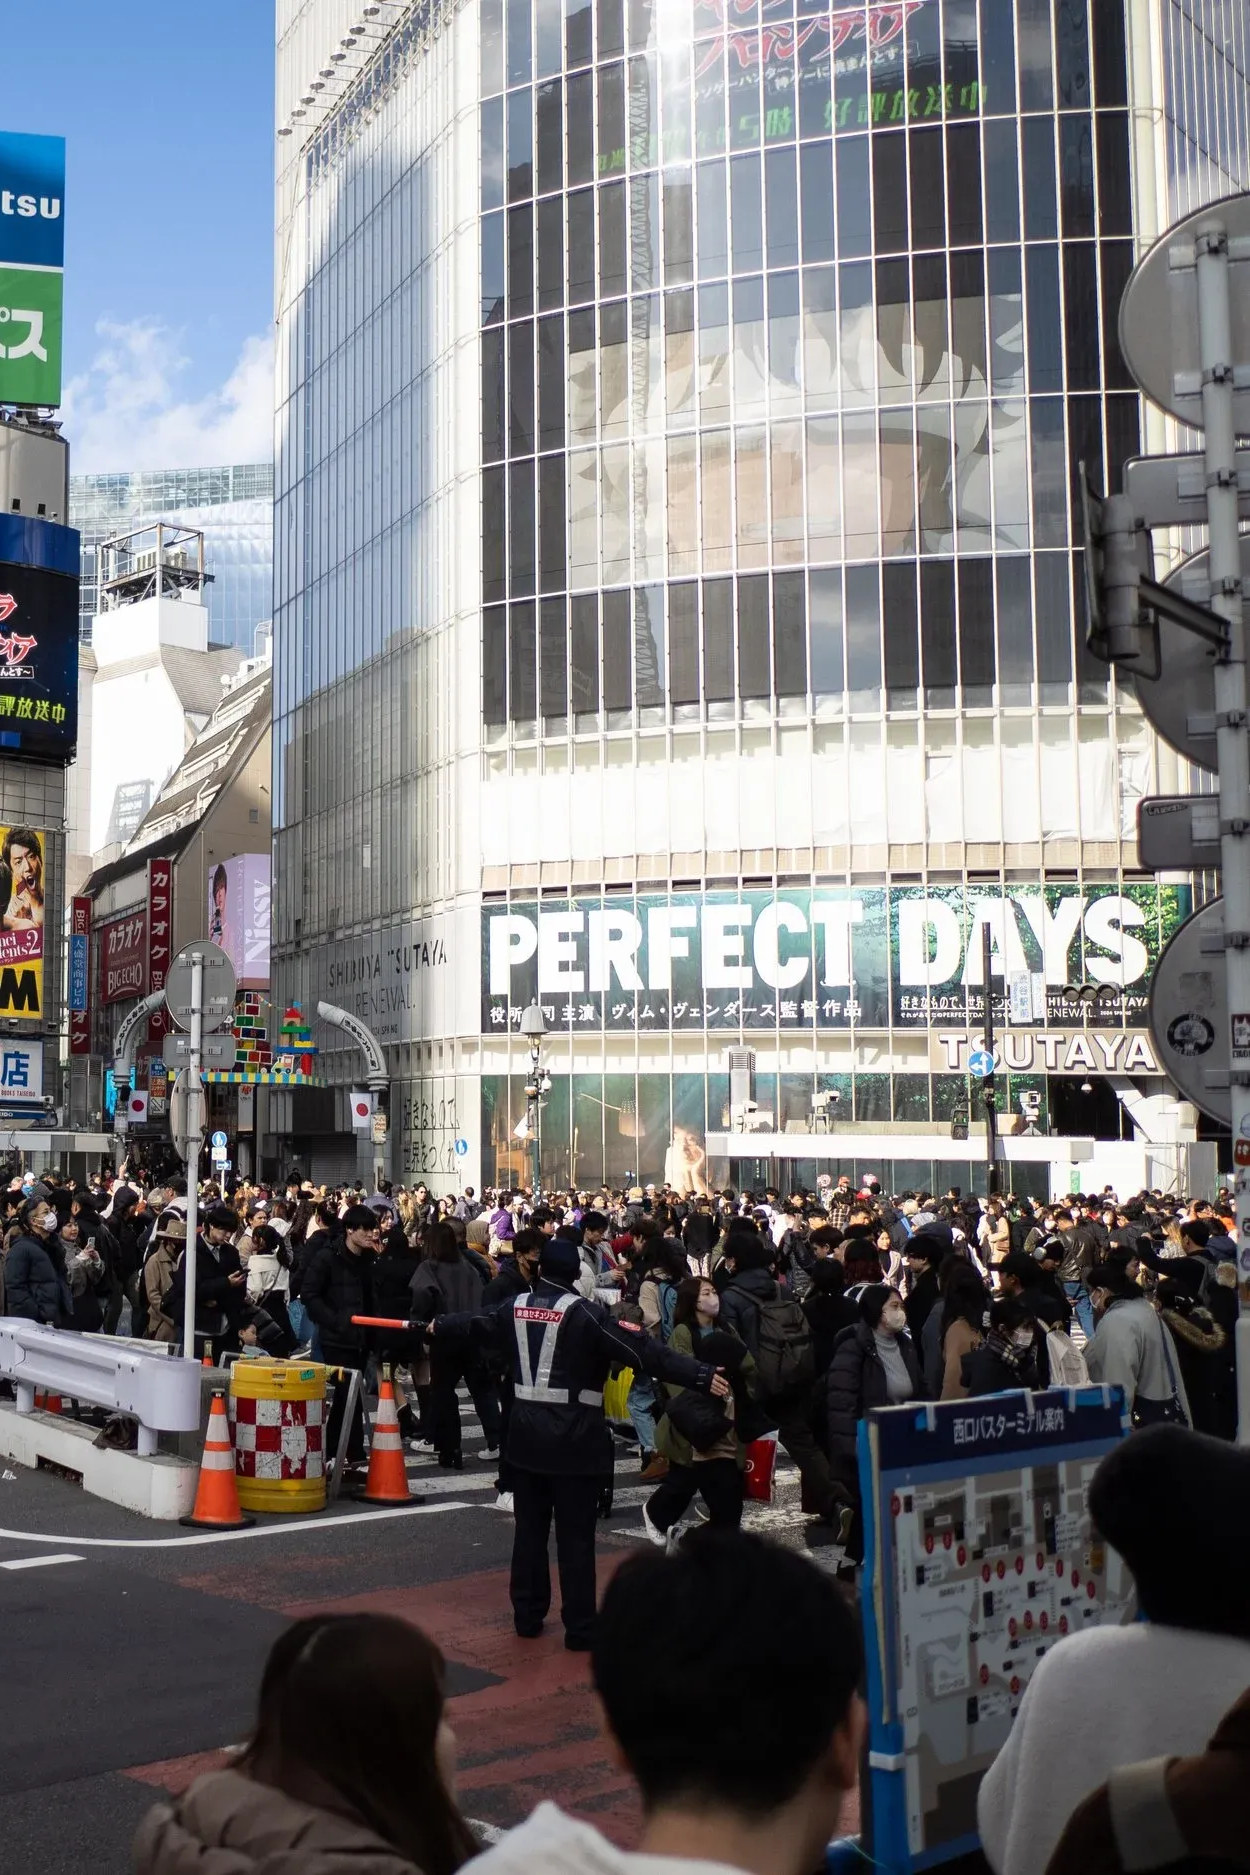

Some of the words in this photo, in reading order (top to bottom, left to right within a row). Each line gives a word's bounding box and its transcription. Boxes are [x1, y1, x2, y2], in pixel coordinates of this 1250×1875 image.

[151, 872, 168, 960] カラオケ
[245, 880, 270, 963] Nissy
[109, 919, 143, 955] カラオケ
[488, 902, 863, 995] PERFECT
[898, 896, 1148, 987] DAYS
[73, 940, 84, 1005] 大盛堂商事ビル
[108, 971, 121, 996] BIG
[121, 962, 143, 990] ECHO
[329, 954, 381, 987] SHIBUYA
[490, 1006, 555, 1023] 役所司
[561, 1005, 594, 1021] 主演
[611, 999, 862, 1019] ヴィム・ヴェンダース監督作品
[900, 995, 1011, 1009] 好きなもので、世界つく
[1047, 1008, 1096, 1018] ENEWAL.
[1048, 997, 1093, 1007] HIBUYA
[72, 1011, 87, 1046] オケ
[381, 1024, 398, 1034] SPRNG
[938, 1032, 1157, 1070] TSUTAYA
[516, 1309, 561, 1322] 東急セキュリティ
[953, 1406, 1065, 1445] 西口バスターミナル案内
